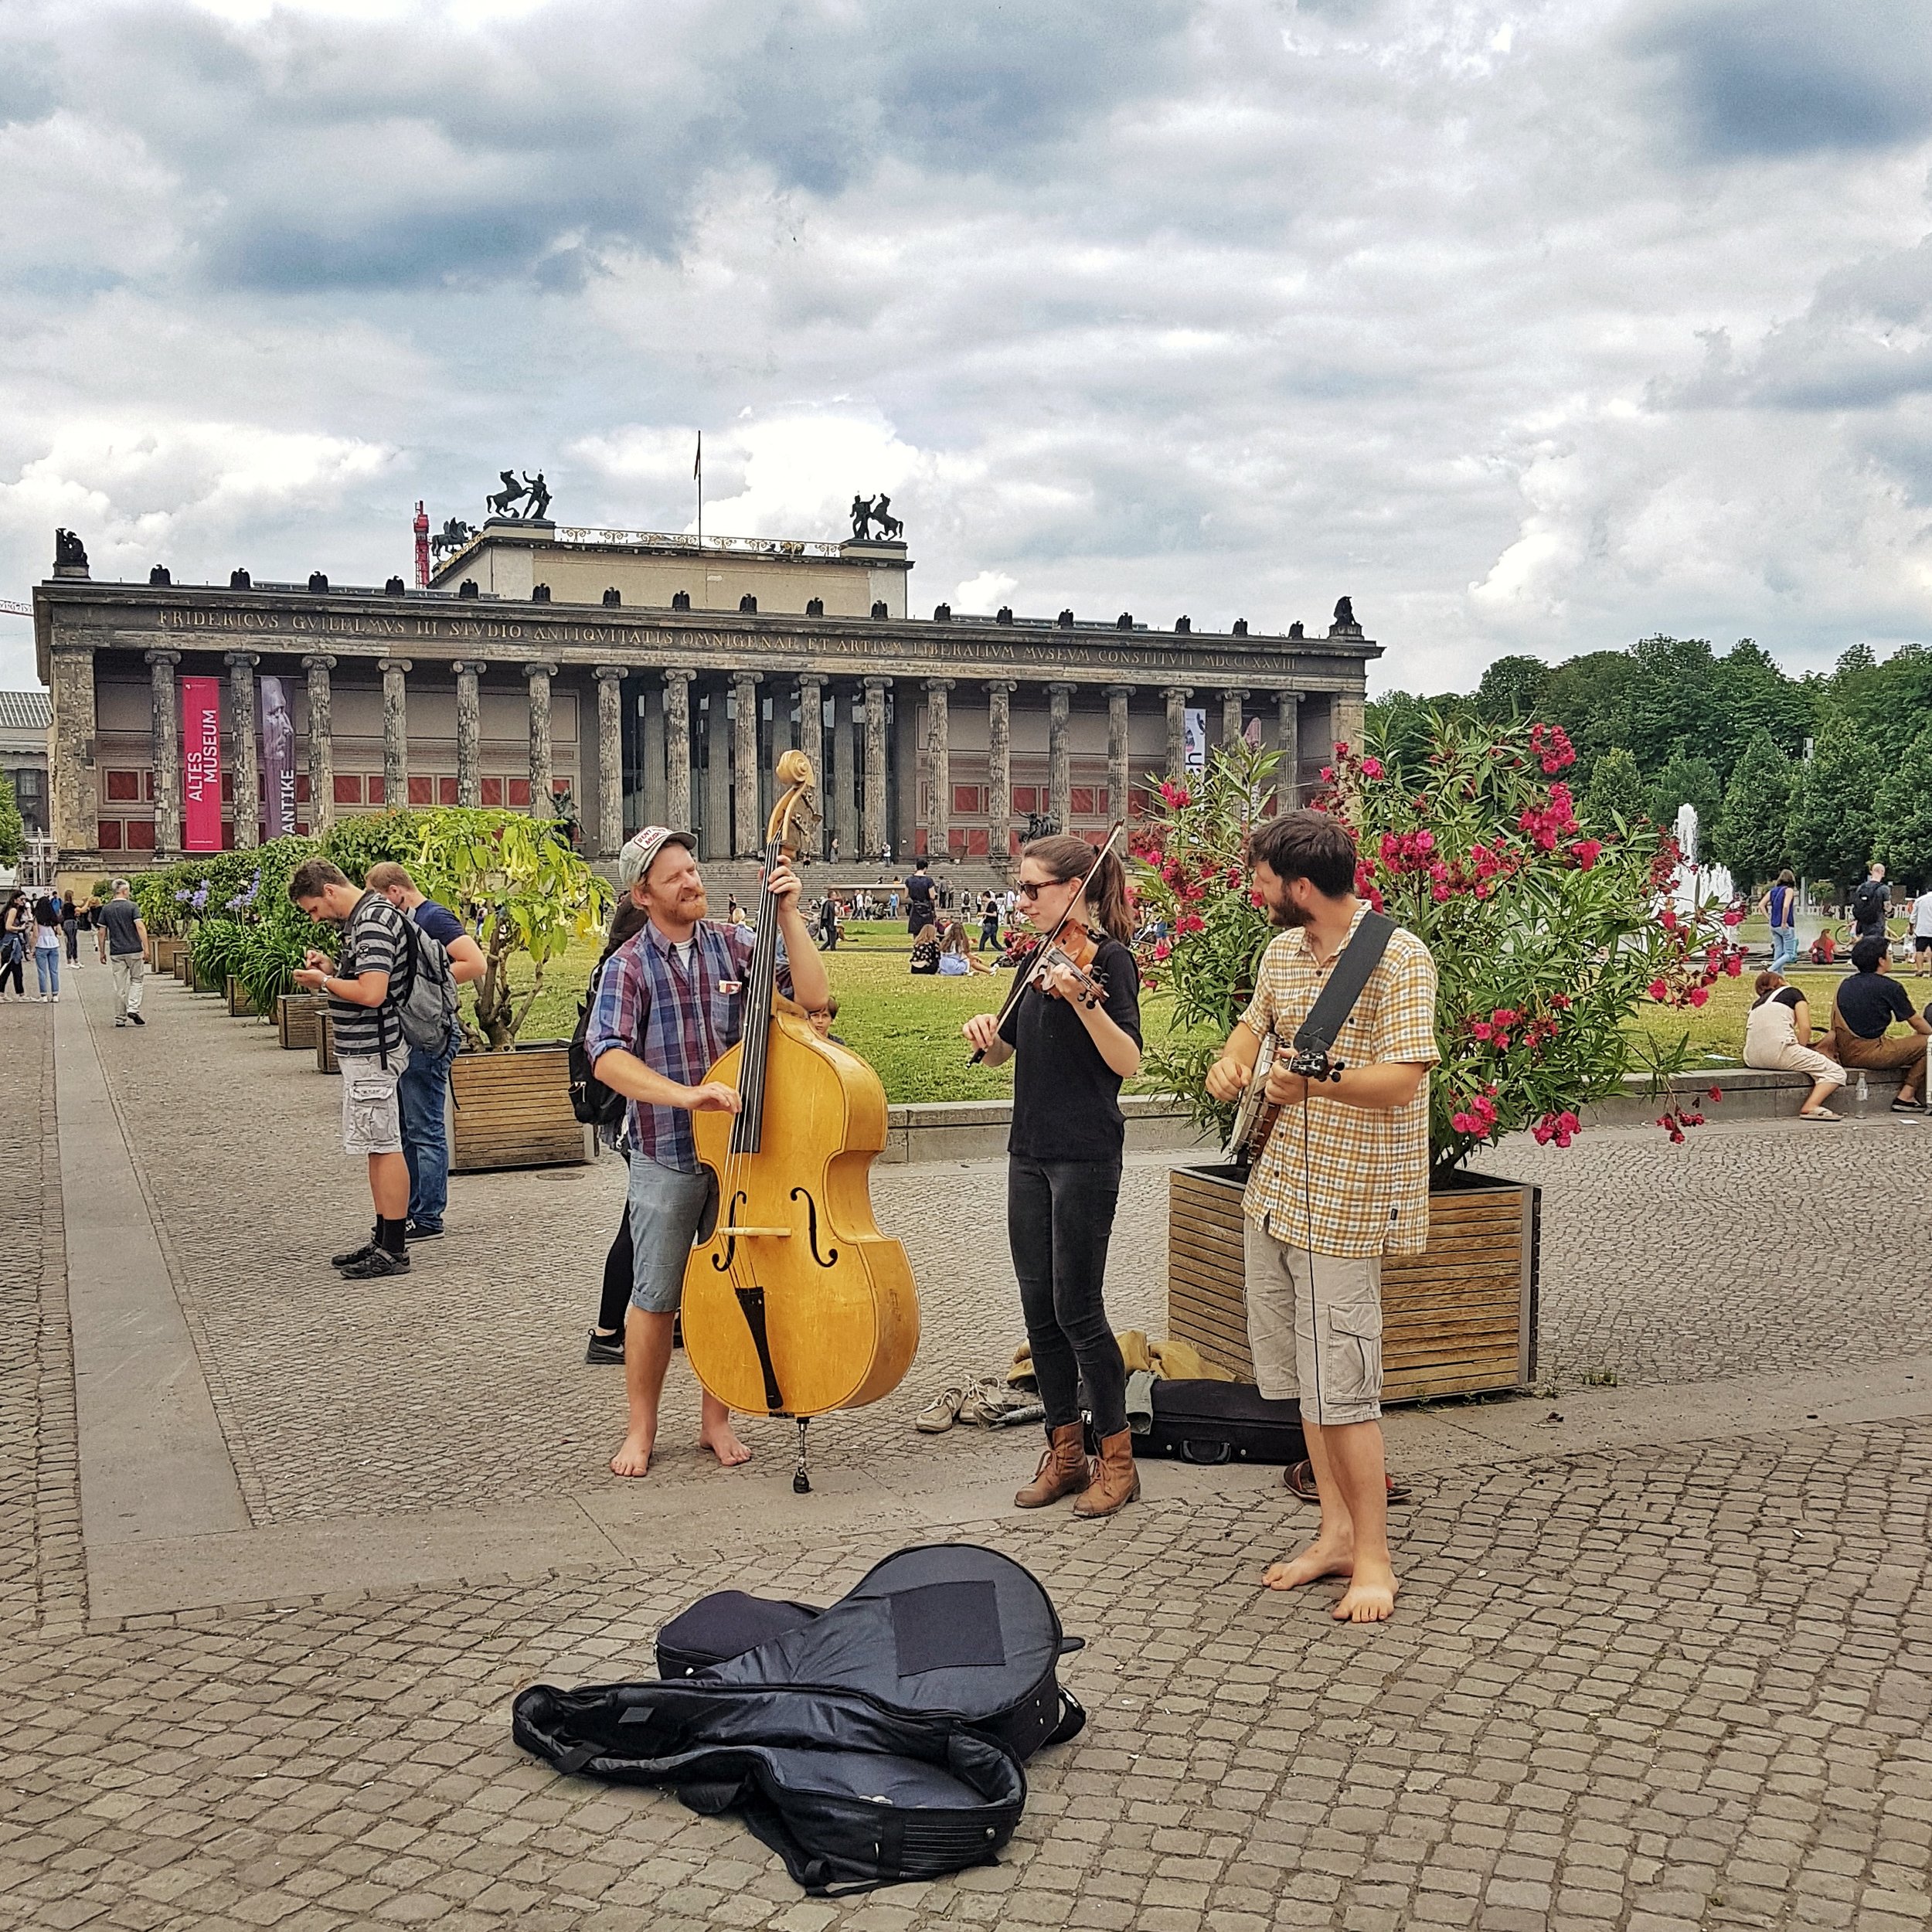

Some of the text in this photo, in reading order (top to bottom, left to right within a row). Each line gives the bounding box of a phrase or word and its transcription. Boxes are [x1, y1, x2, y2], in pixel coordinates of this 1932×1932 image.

[417, 621, 437, 634] III
[449, 622, 522, 638] STVDIO
[534, 625, 673, 645] ANTIQVITATIS
[808, 637, 830, 651] ET
[836, 640, 903, 655] ARTIVM
[1023, 647, 1090, 662] MVSEVM
[1098, 650, 1193, 666] CONSTITVIT
[202, 709, 218, 783] MUSEUM
[187, 752, 203, 802] ALTES
[280, 769, 297, 834] ANTIKE
